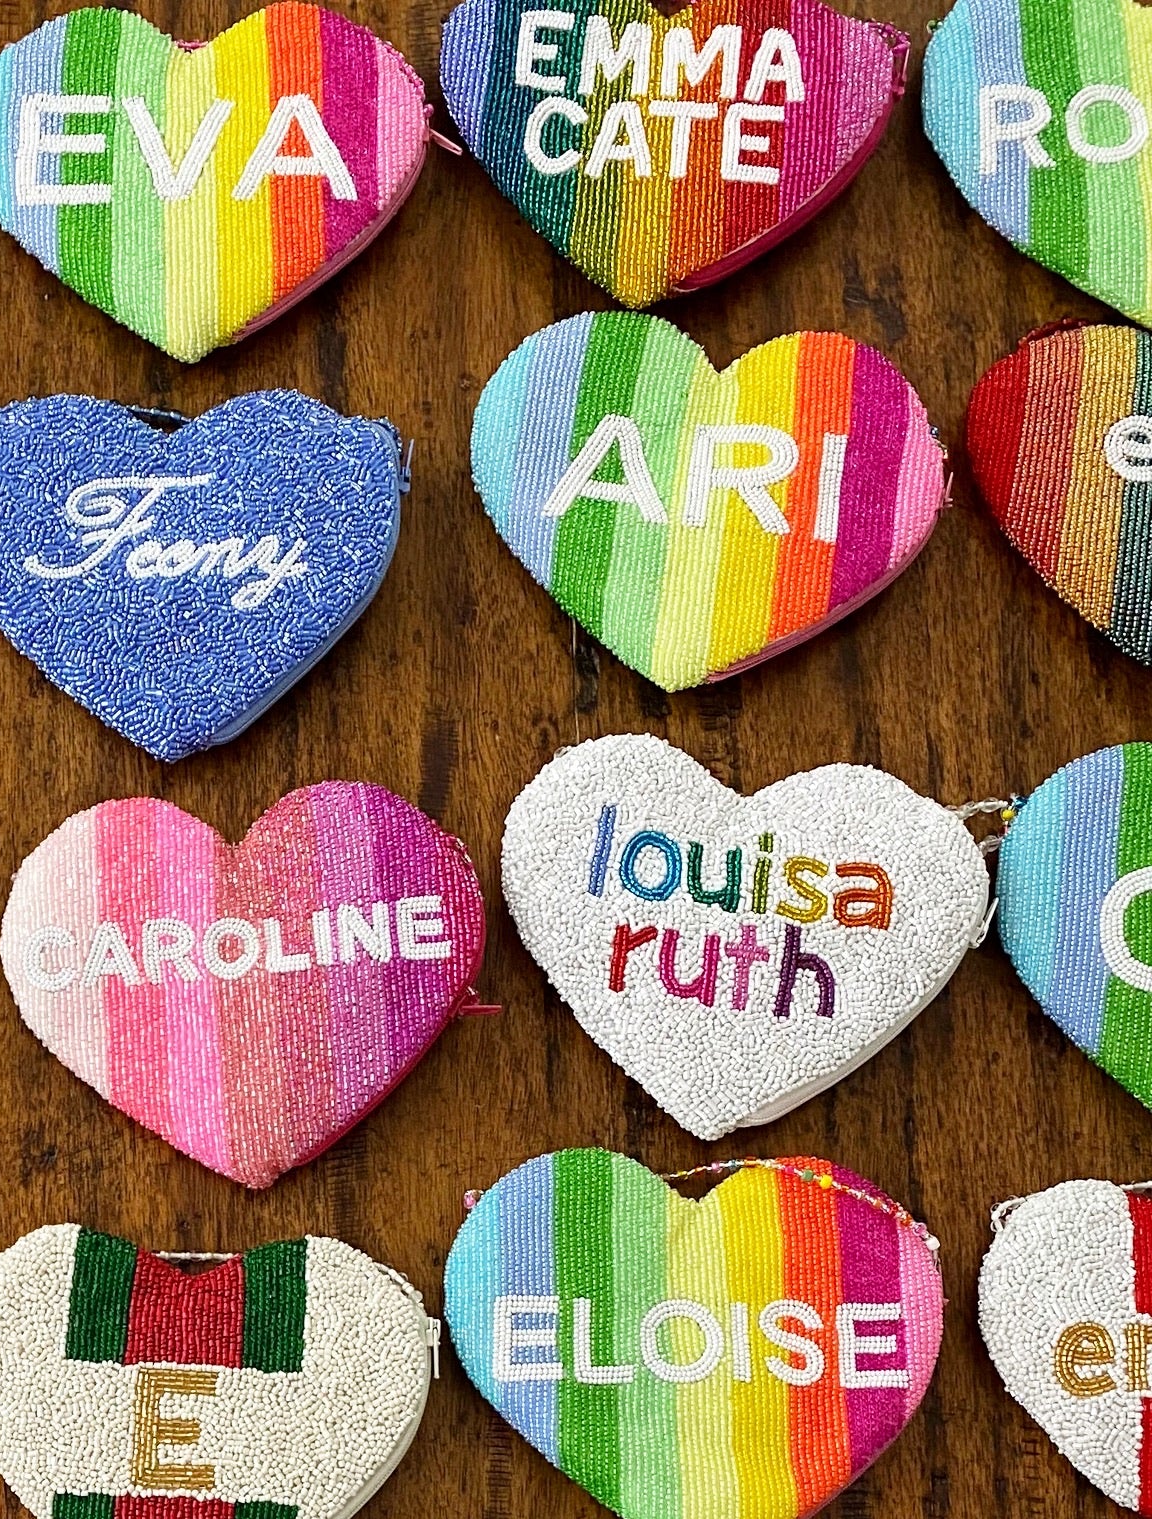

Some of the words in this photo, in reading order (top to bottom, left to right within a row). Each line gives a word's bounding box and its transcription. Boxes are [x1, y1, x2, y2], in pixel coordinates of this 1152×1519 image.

[515, 9, 804, 102] EMMA
[15, 93, 358, 205] EVA
[523, 100, 785, 185] CATE
[543, 413, 848, 543] ARI
[588, 805, 894, 931] louisa
[21, 894, 451, 993] CAROLINE
[609, 923, 835, 1019] ruth
[491, 1294, 911, 1389] ELOISE
[131, 1368, 218, 1489] E
